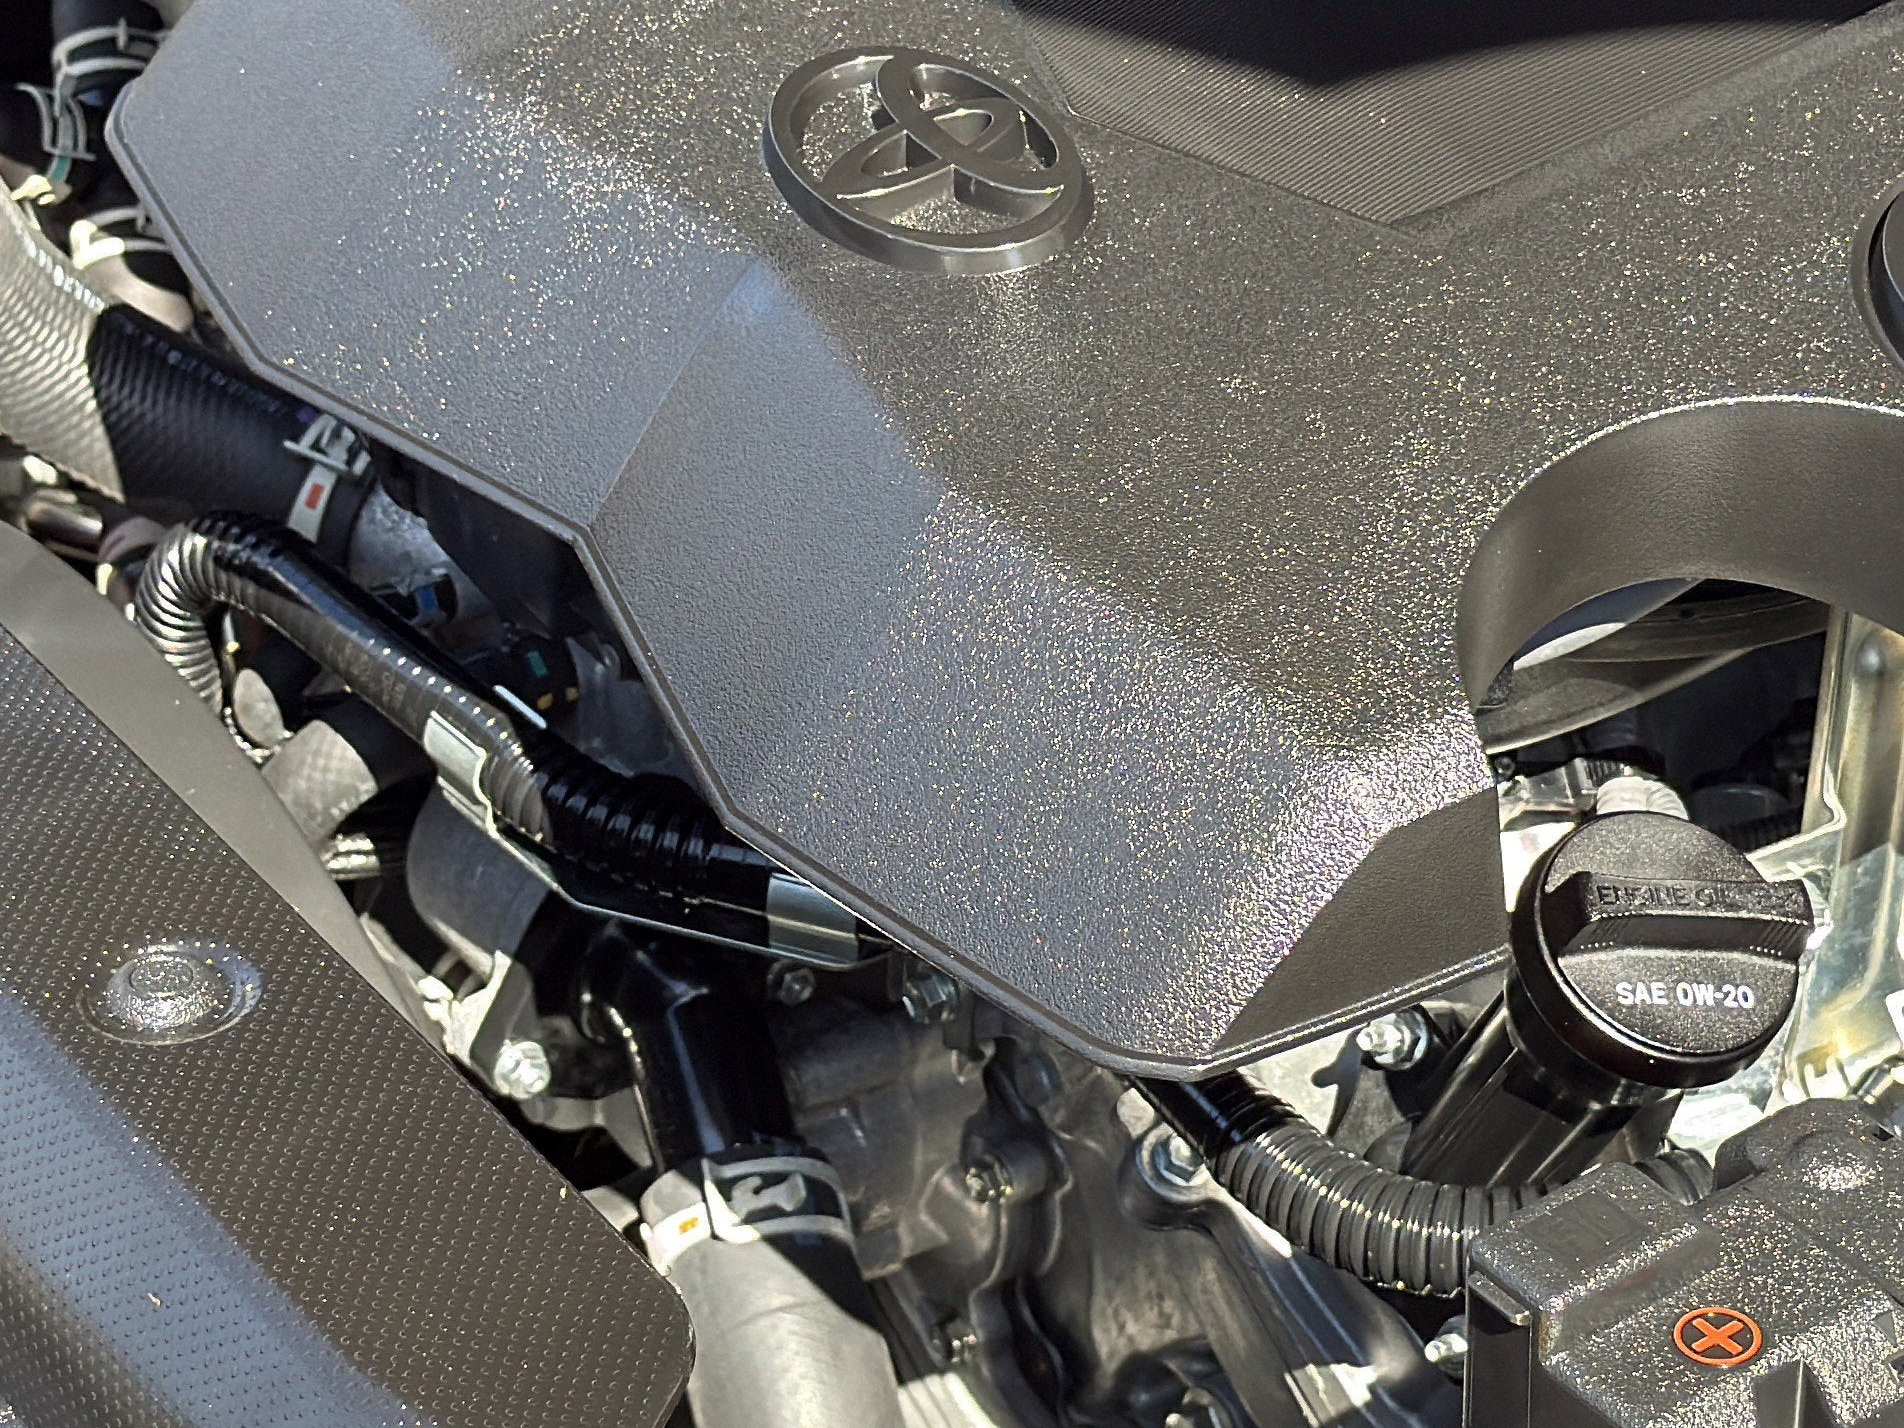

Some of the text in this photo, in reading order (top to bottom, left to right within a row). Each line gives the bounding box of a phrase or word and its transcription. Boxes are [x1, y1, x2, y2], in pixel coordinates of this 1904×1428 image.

[1595, 883, 1691, 906] ENGINE
[1615, 981, 1755, 1009] SAE 0W-20
